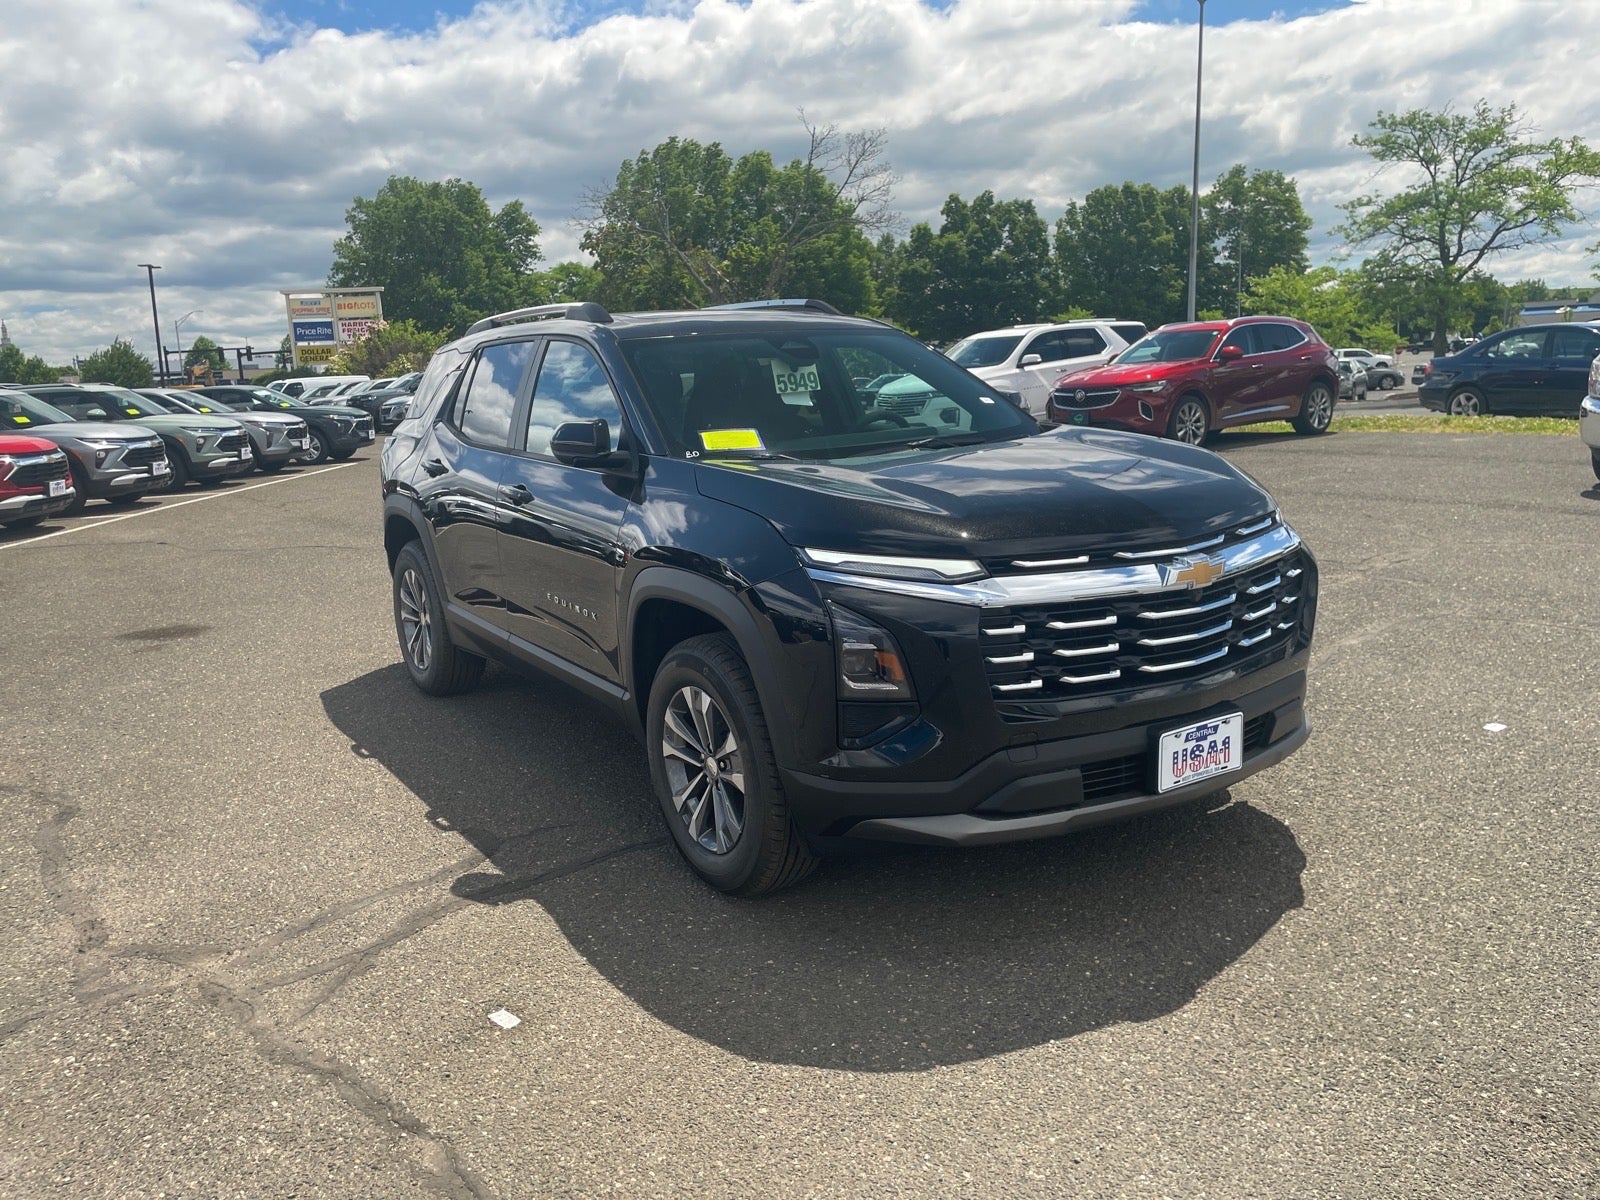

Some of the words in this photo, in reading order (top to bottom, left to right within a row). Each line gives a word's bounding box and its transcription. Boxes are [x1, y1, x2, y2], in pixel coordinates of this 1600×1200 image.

[296, 327, 316, 336] Price
[317, 327, 332, 335] Rite
[300, 355, 332, 363] GENERA
[776, 371, 819, 393] 5949
[546, 592, 597, 622] EQUINOX
[1188, 727, 1216, 740] CENTRAL
